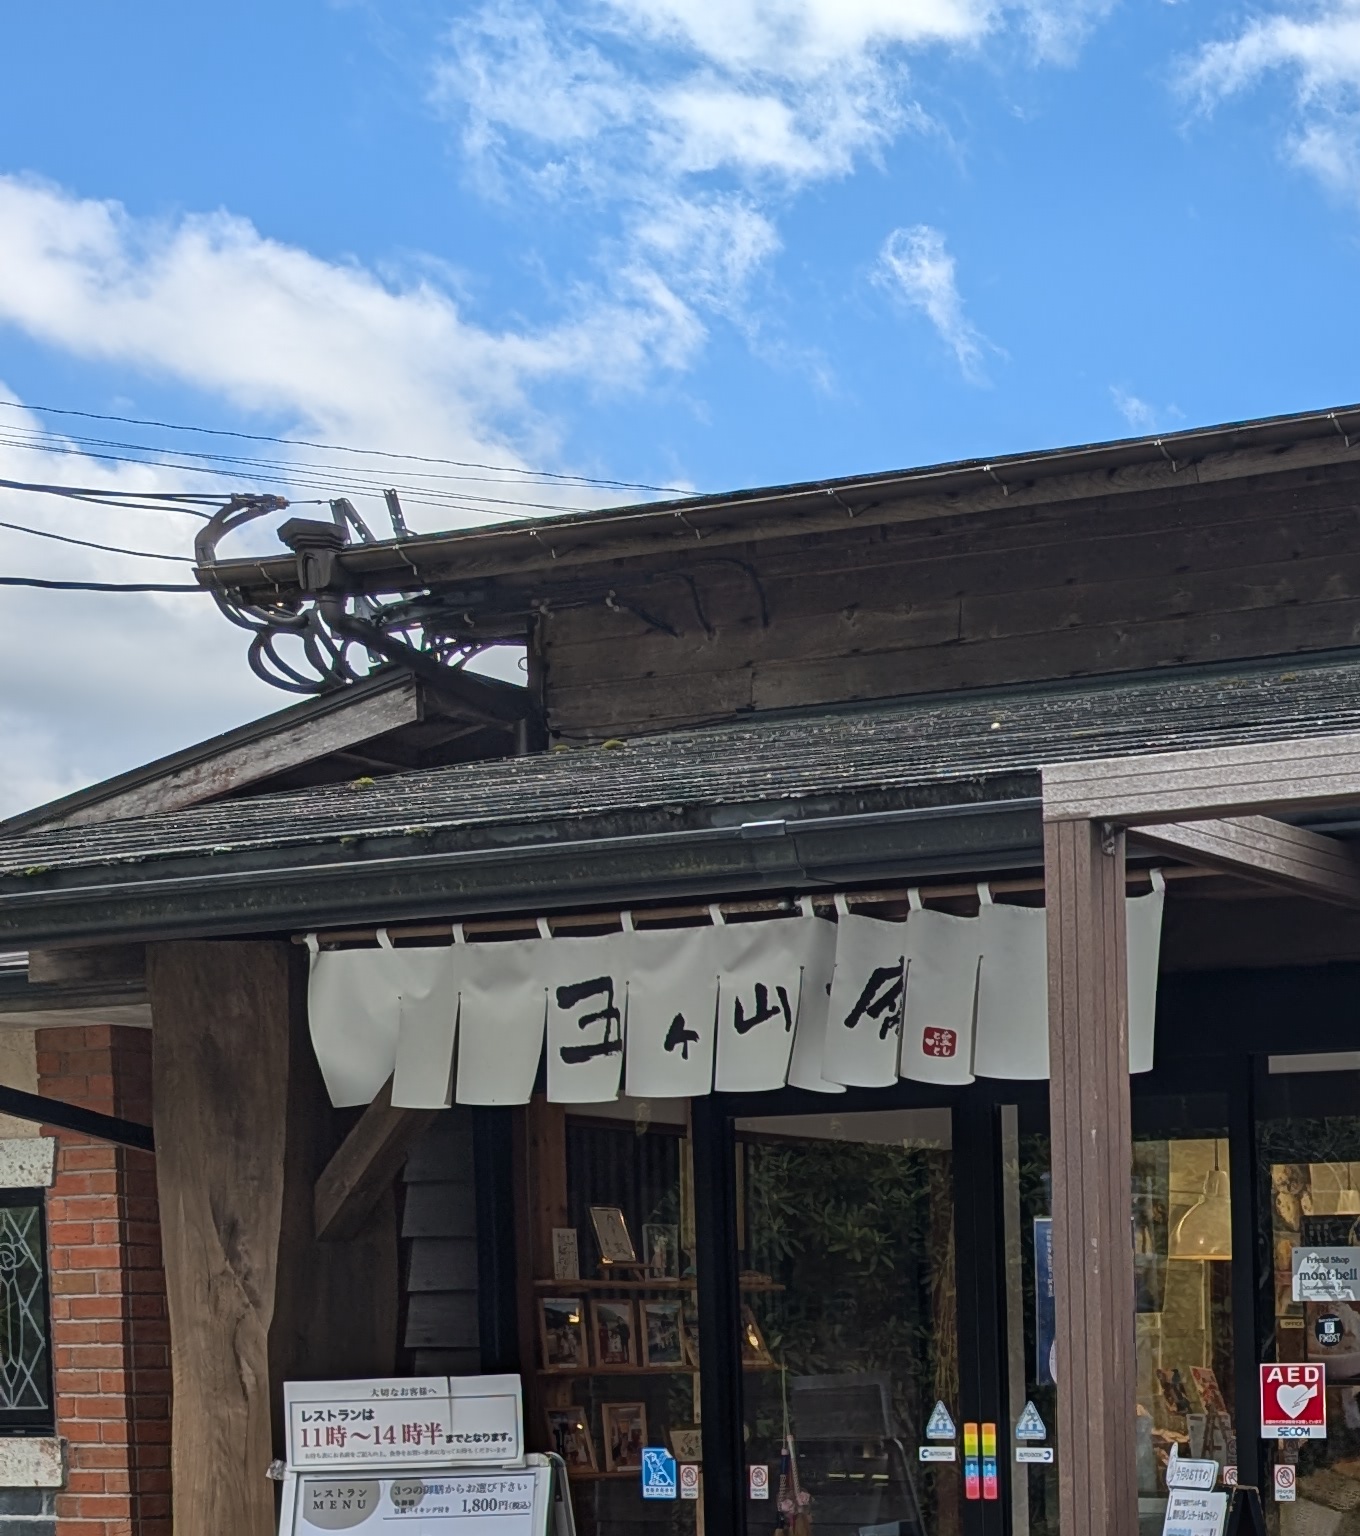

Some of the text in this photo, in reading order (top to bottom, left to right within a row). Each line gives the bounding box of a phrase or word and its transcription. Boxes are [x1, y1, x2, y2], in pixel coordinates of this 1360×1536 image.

[1266, 1367, 1320, 1384] AED
[371, 1386, 438, 1398] 大切なお客様へ
[301, 1408, 375, 1423] レストランは
[1277, 1426, 1311, 1437] SECOM
[312, 1488, 368, 1499] レストラン
[312, 1500, 367, 1510] MENU
